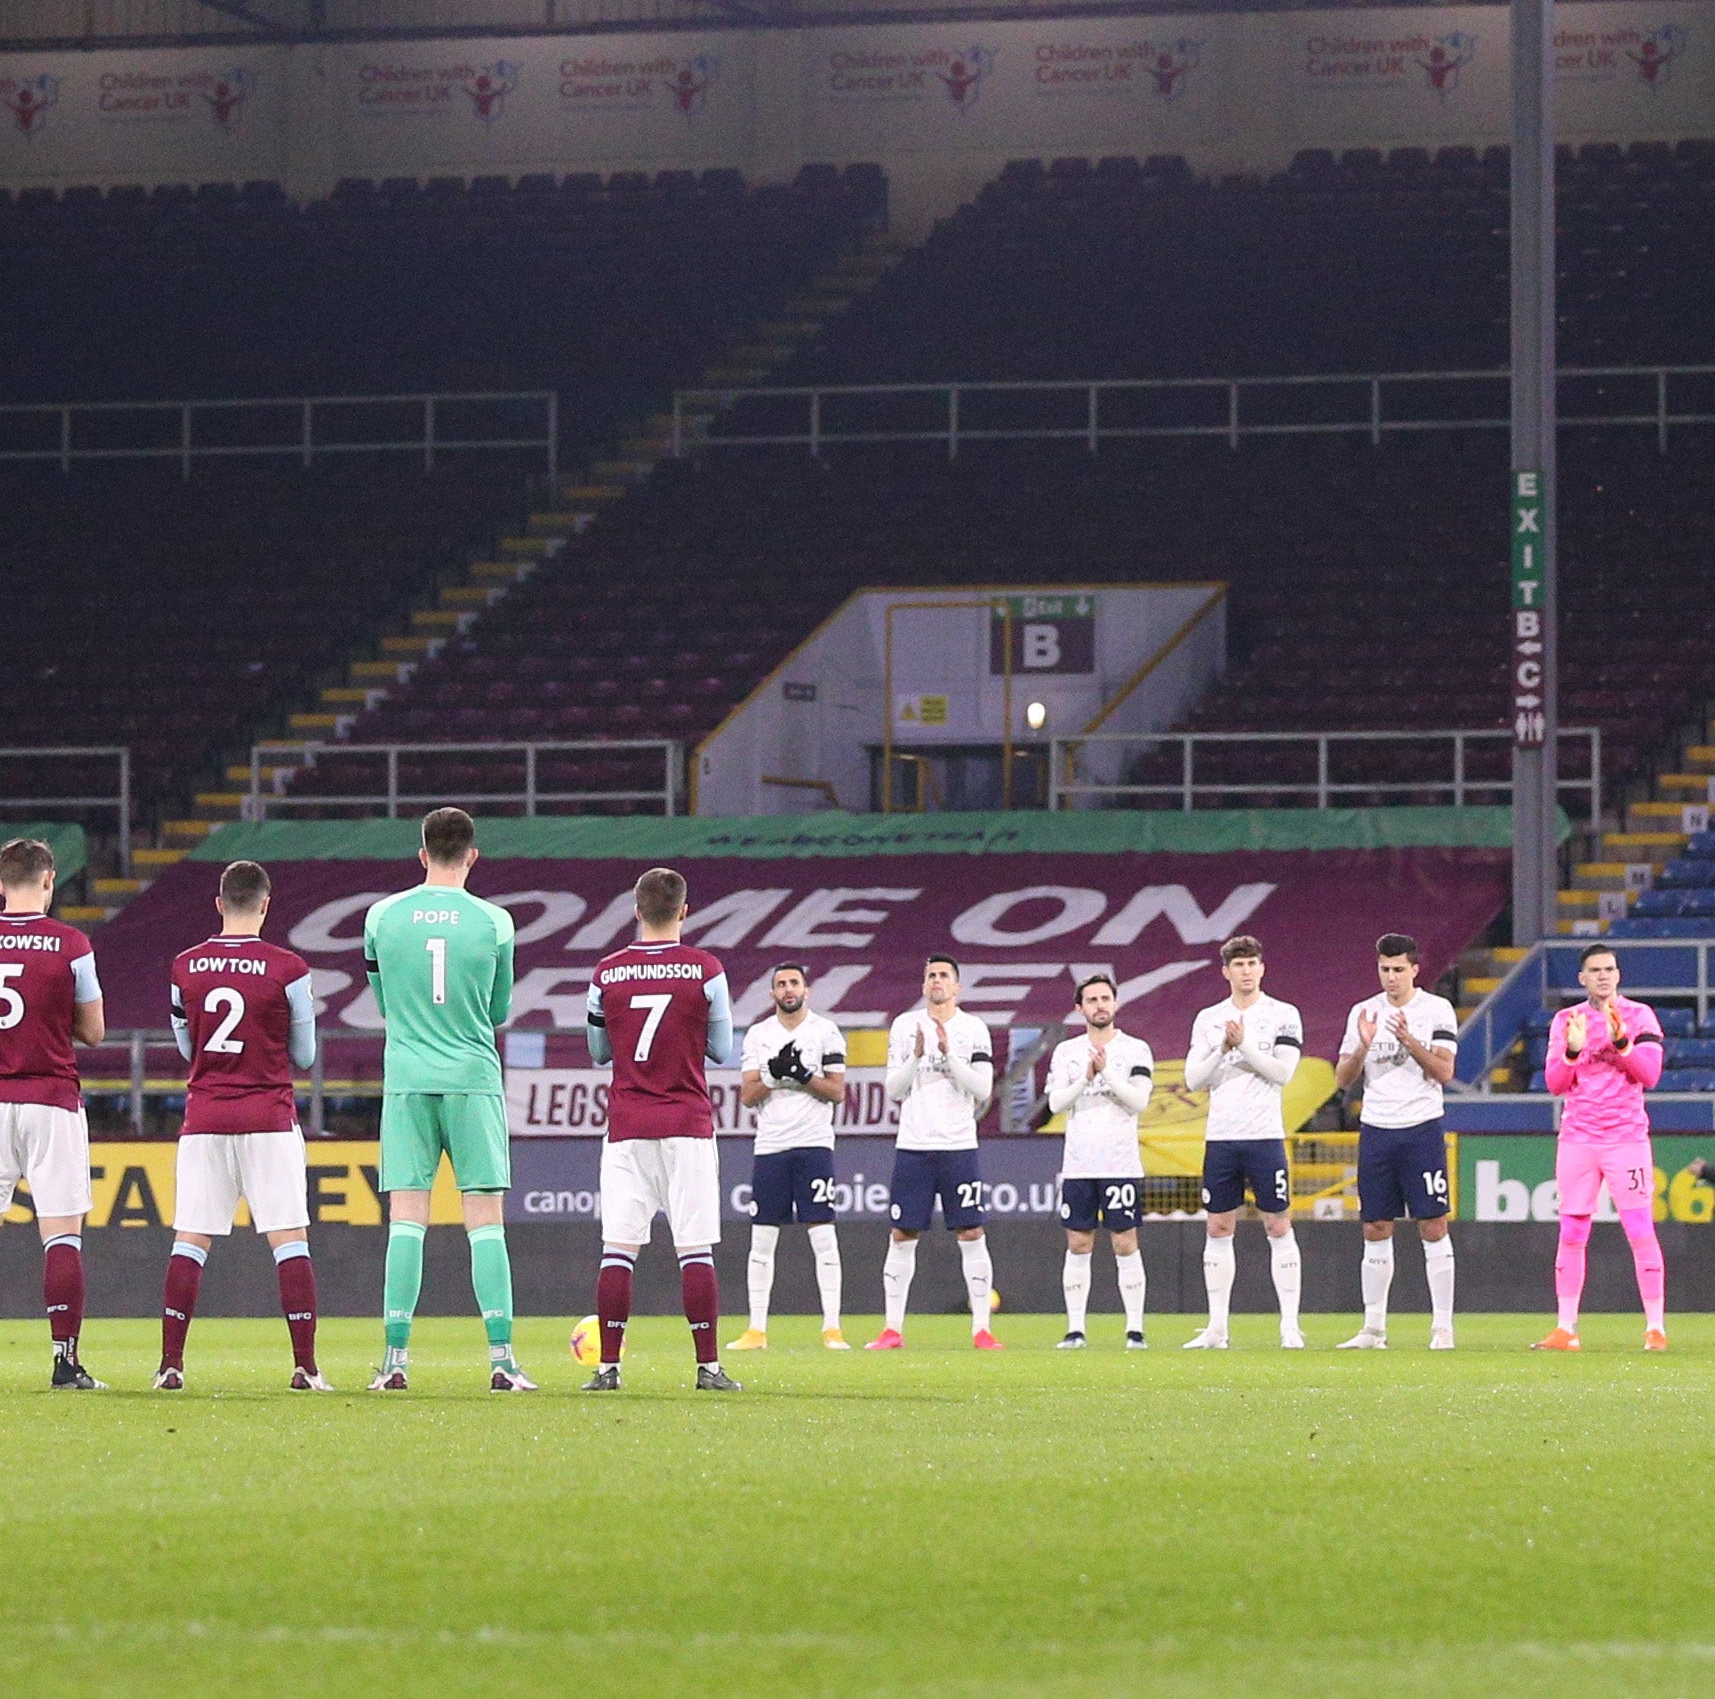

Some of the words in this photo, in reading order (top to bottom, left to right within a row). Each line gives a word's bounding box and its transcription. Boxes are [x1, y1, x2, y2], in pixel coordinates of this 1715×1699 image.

[1516, 471, 1540, 606] EXIT
[1516, 610, 1541, 638] B
[1023, 624, 1061, 668] B
[1517, 660, 1542, 688] C
[413, 909, 460, 926] POPE
[950, 883, 1278, 948] ON
[188, 957, 267, 978] LOWTON
[426, 936, 446, 1005] 1
[599, 963, 703, 985] GUDMUNDSSON
[203, 986, 246, 1054] 2
[628, 993, 673, 1062] 7
[809, 1177, 837, 1204] 26
[1274, 1169, 1288, 1196] 5
[1423, 1169, 1448, 1196] 16
[1627, 1166, 1646, 1192] 31
[956, 1180, 983, 1208] 27
[1105, 1182, 1137, 1210] 20
